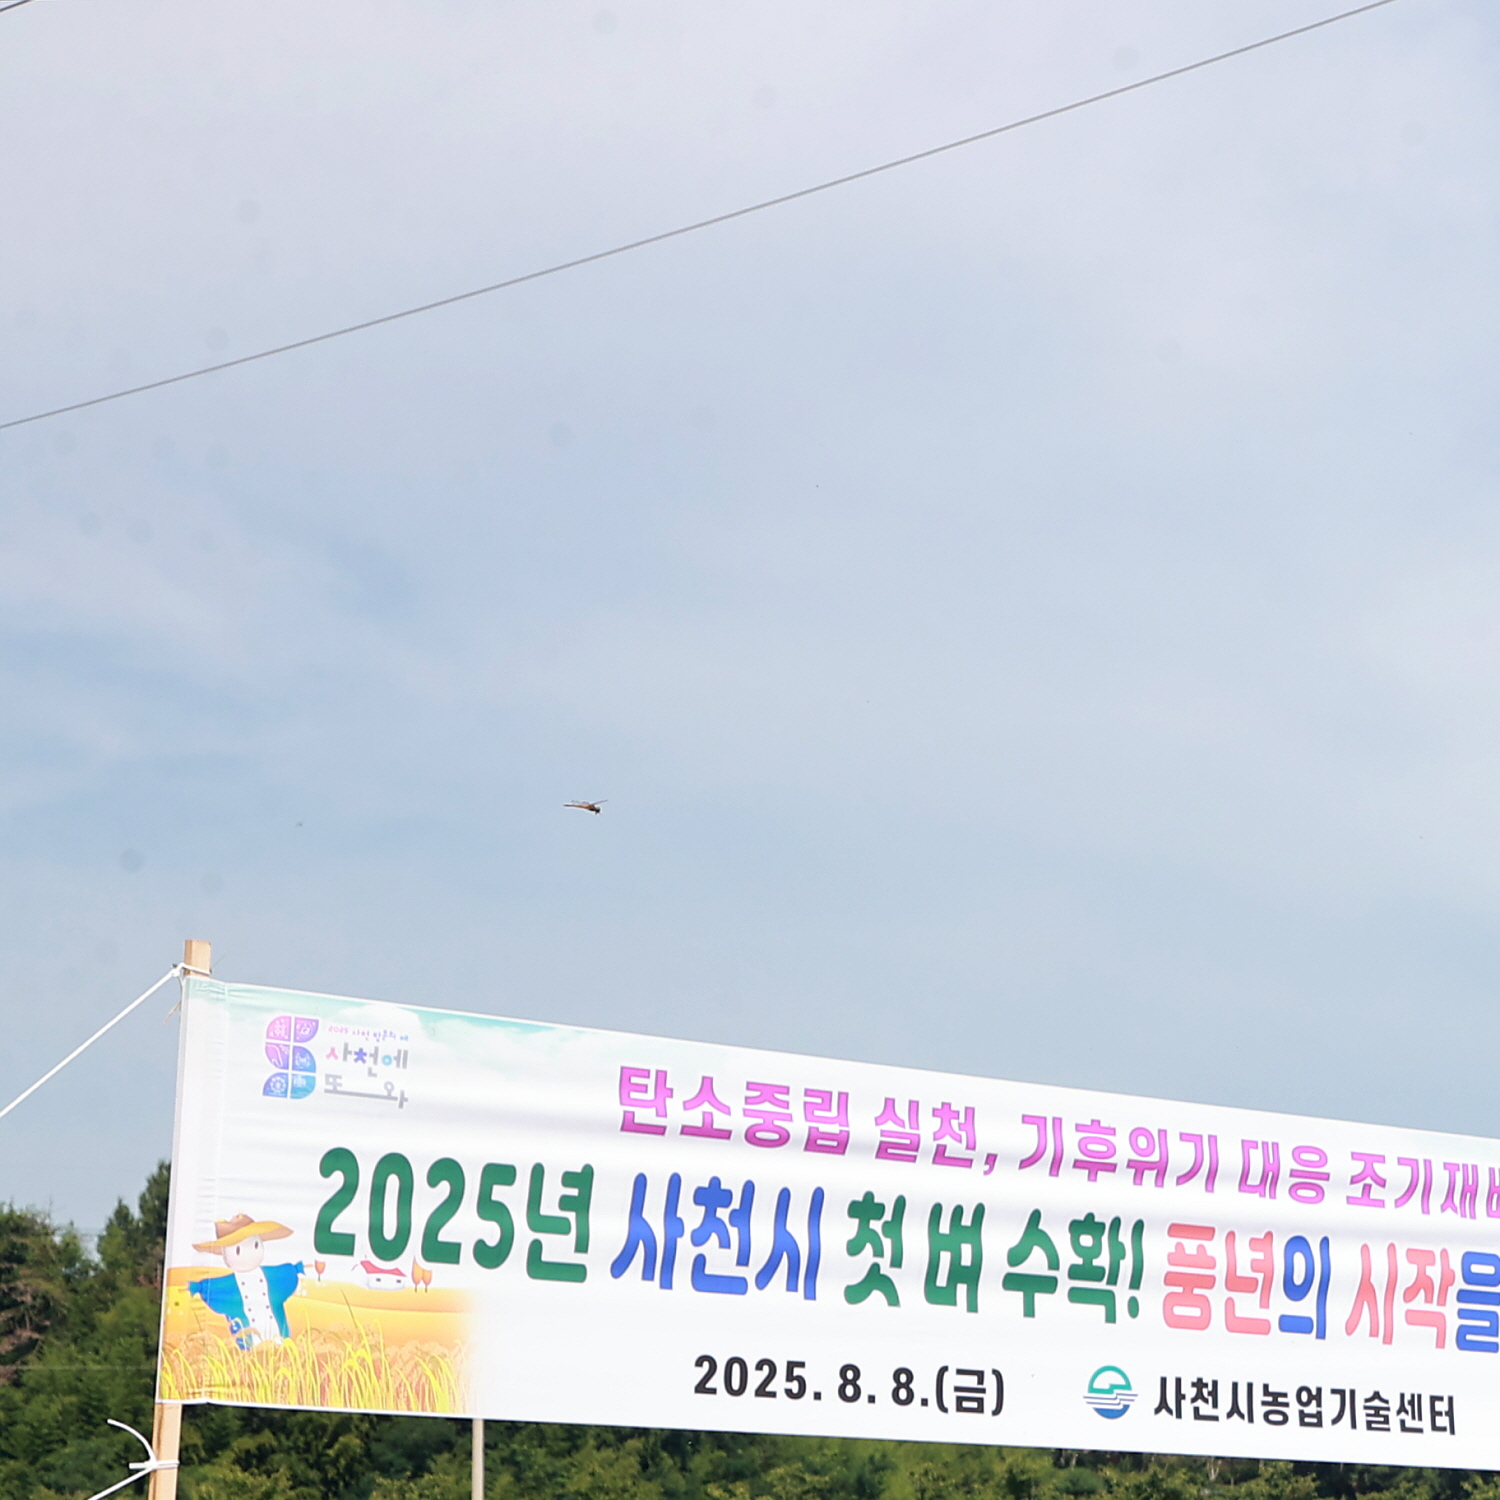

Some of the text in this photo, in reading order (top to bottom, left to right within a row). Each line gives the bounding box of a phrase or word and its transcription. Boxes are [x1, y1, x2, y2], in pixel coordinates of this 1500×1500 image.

[326, 1042, 408, 1077] 사천에
[620, 1067, 849, 1155] 탄소중립
[875, 1098, 997, 1175] 실천,
[1020, 1115, 1218, 1192] 기후위기
[1239, 1140, 1330, 1204] 대응
[315, 1148, 593, 1284] 2025년
[611, 1173, 825, 1300] 사천시
[845, 1191, 905, 1307] 첫
[925, 1203, 984, 1312] 벼
[1003, 1209, 1144, 1323] 수확!
[1164, 1223, 1331, 1339] 풍년의
[1154, 1377, 1456, 1436] 사천시농업기술센터
